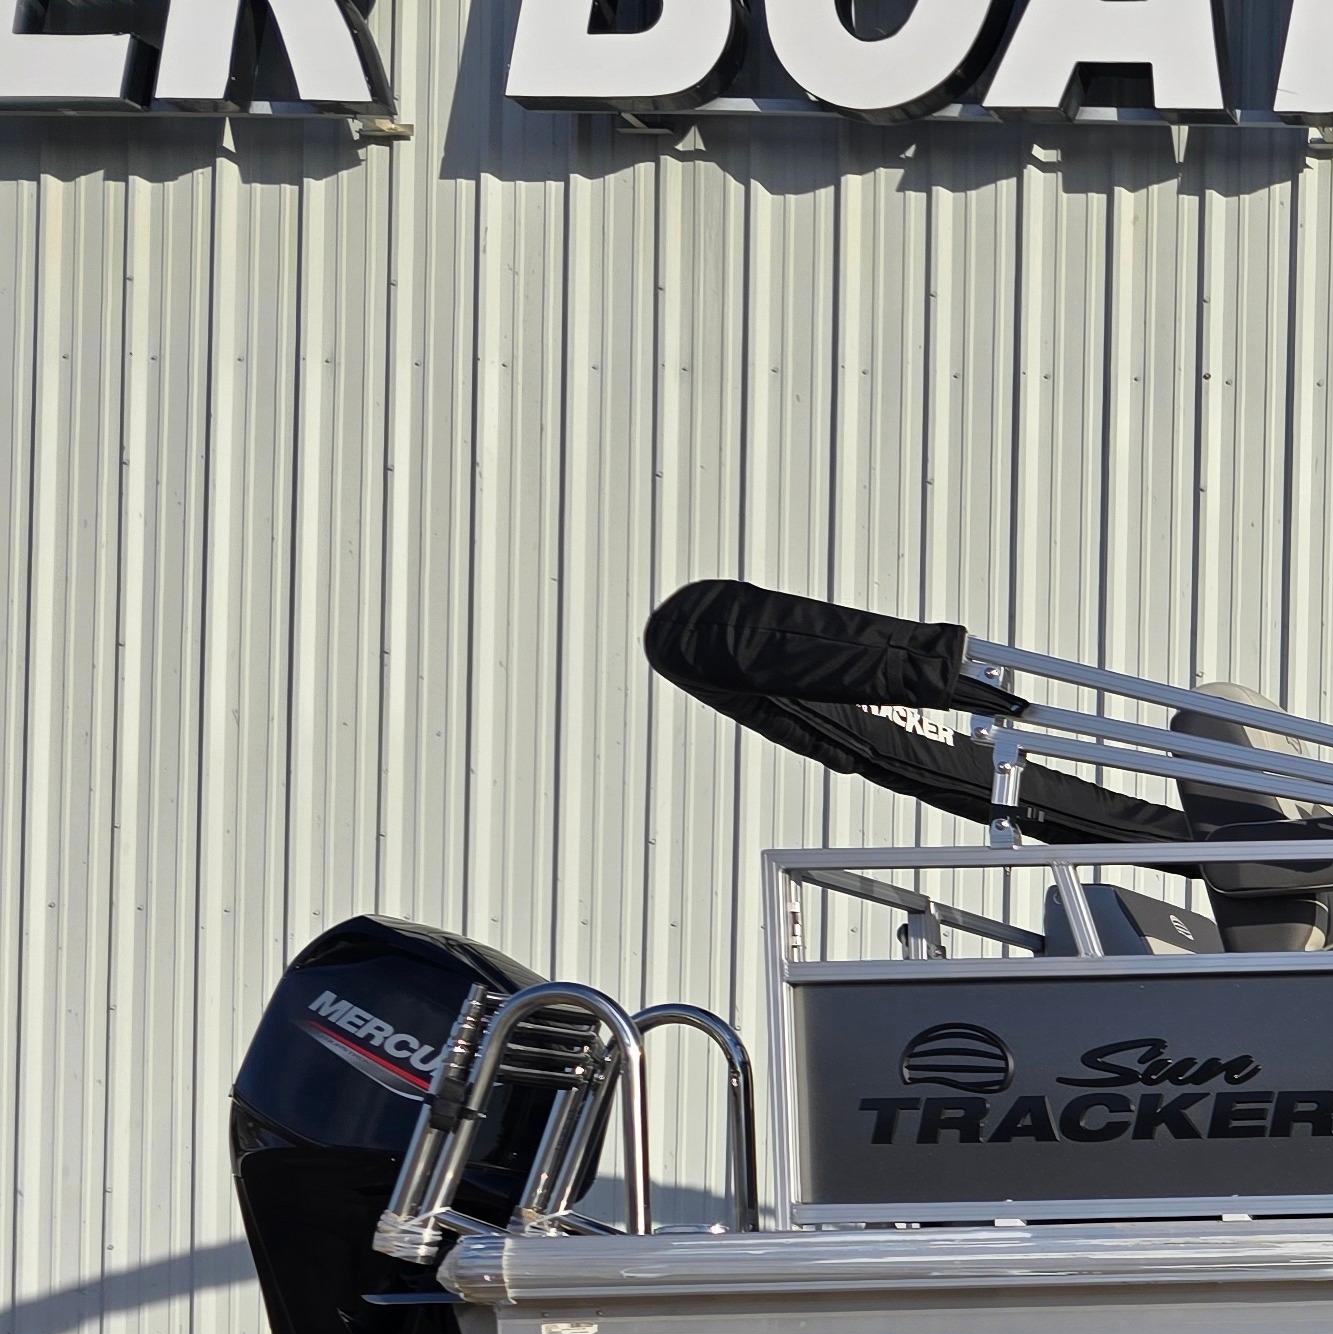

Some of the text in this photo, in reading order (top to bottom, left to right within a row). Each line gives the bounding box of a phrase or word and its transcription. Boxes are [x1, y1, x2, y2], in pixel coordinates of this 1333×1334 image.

[856, 704, 954, 746] ACKER
[308, 990, 441, 1071] MERCU
[1056, 1037, 1262, 1087] Sun
